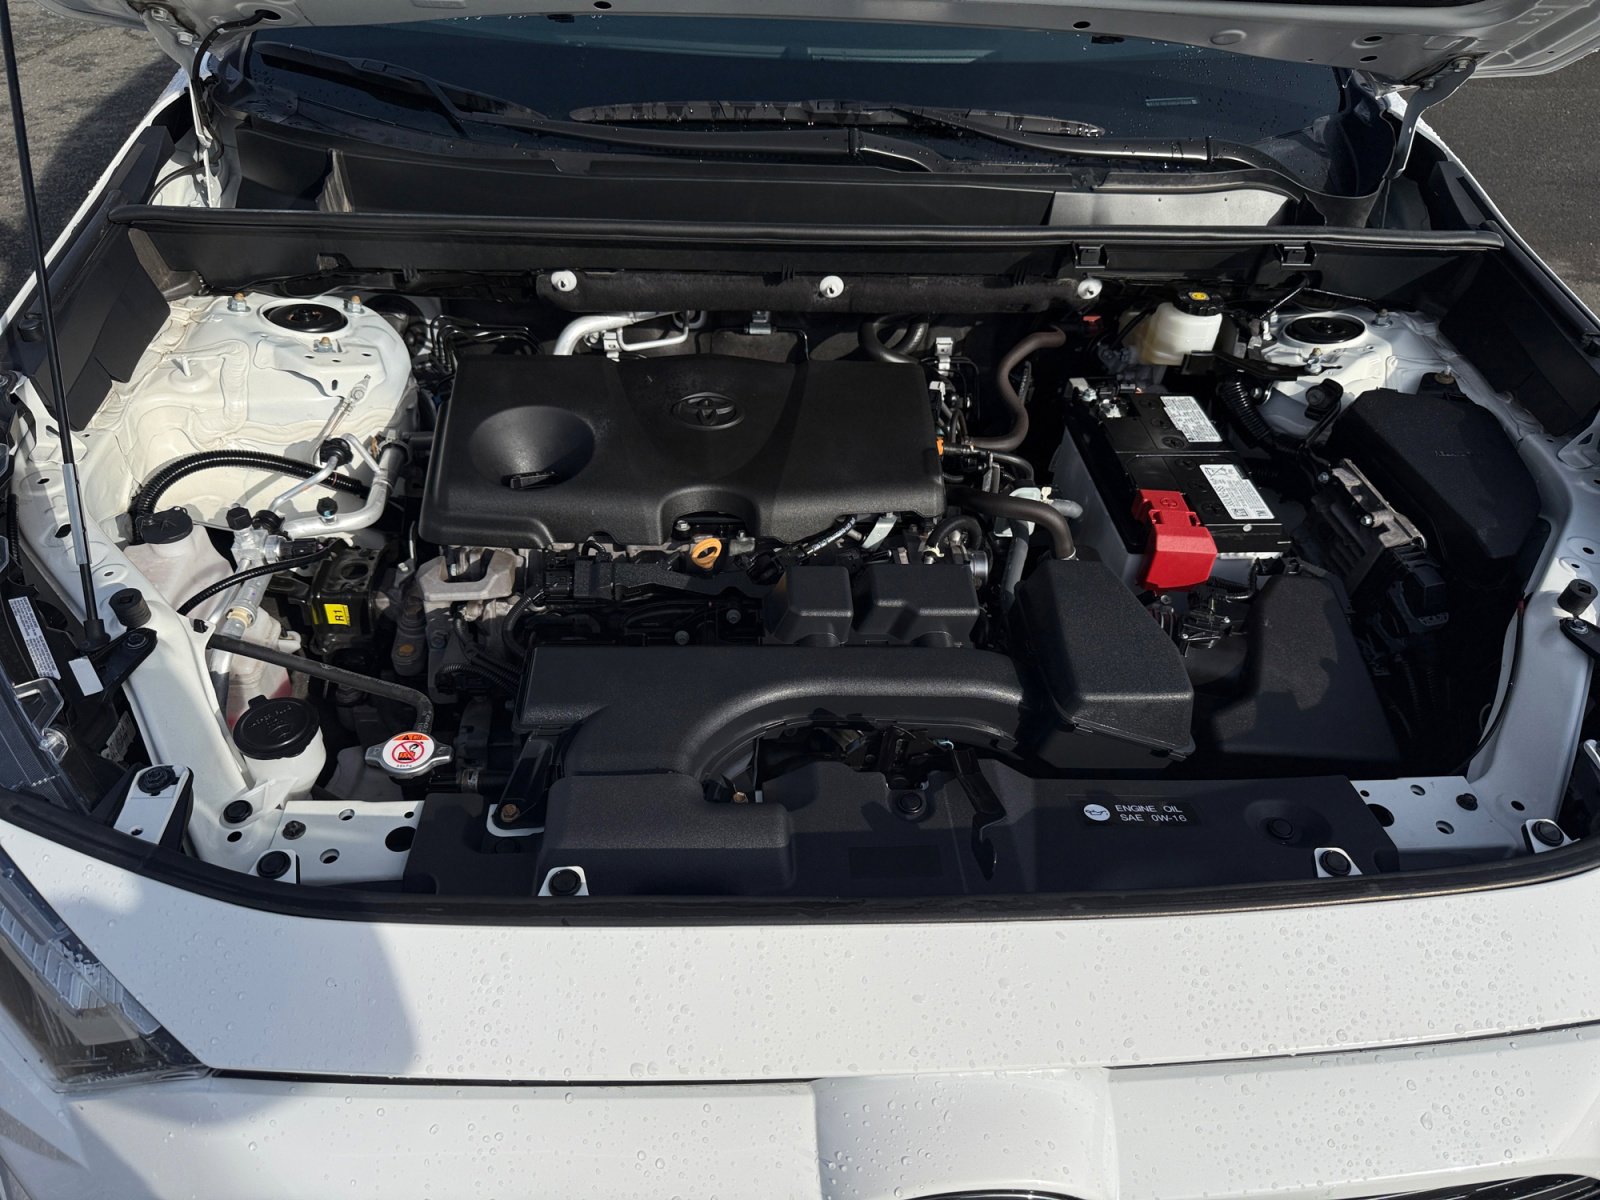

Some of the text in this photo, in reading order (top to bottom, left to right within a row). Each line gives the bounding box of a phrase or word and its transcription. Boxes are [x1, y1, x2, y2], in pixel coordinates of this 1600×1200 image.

[1115, 804, 1183, 813] ENGINE OIL
[1120, 813, 1188, 822] SAE 0W-16
